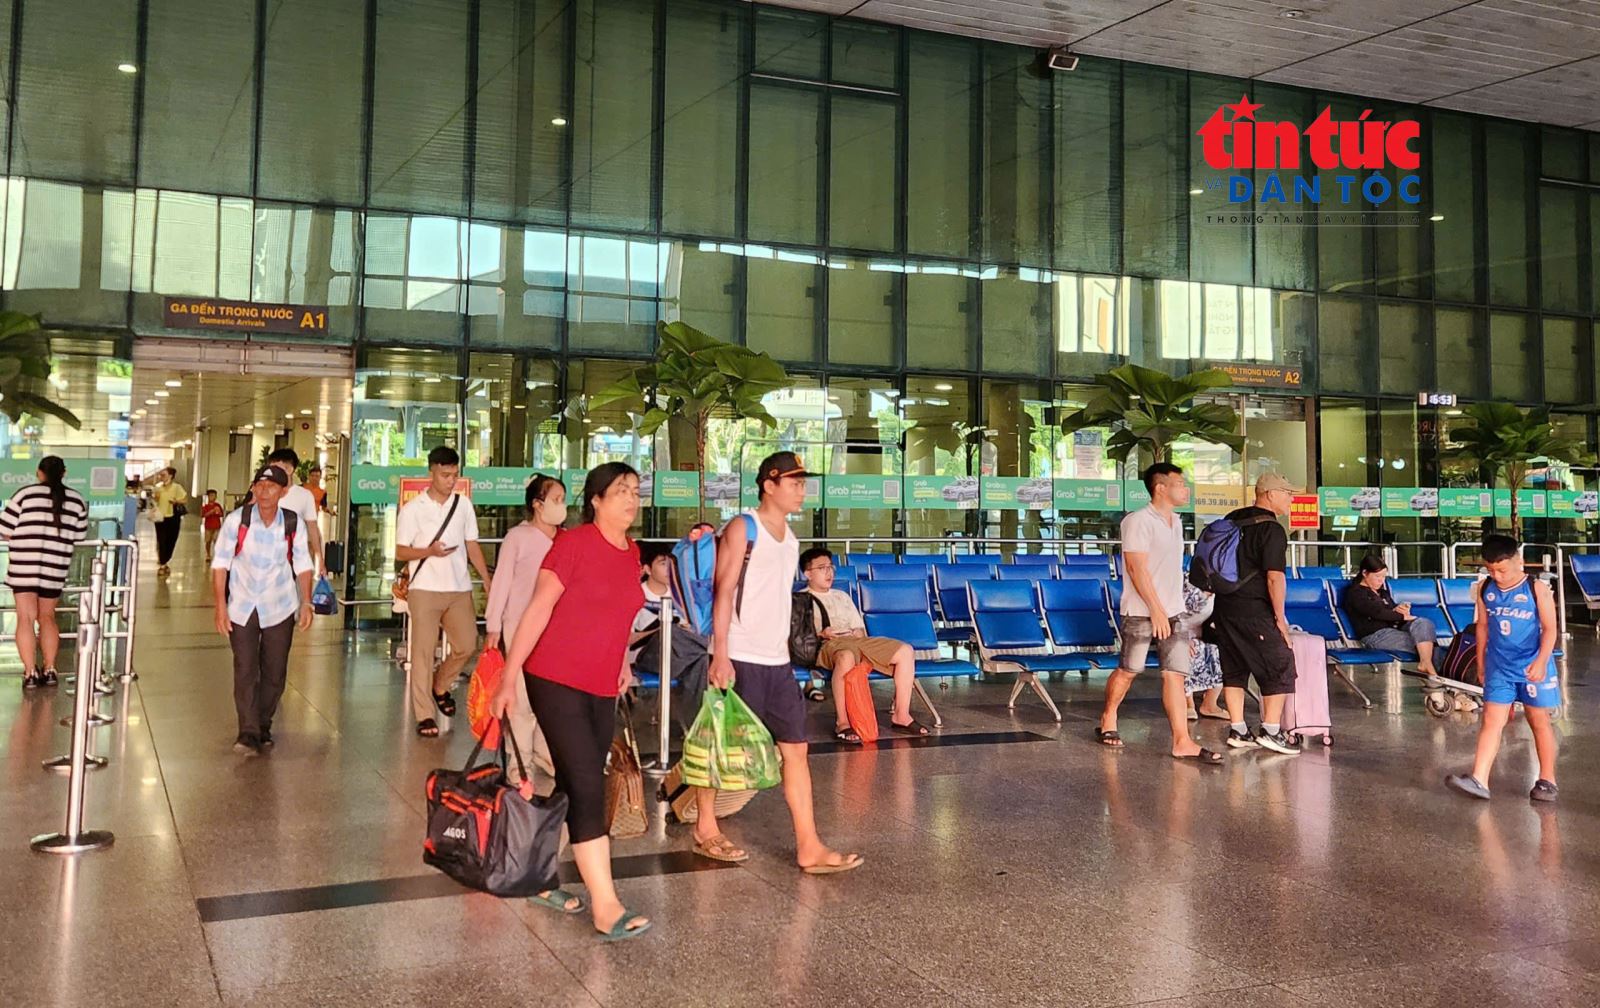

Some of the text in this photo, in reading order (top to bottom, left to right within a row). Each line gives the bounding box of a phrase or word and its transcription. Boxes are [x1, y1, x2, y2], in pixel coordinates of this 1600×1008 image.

[170, 302, 293, 320] GA ĐẾN TRONG NƯỚC
[200, 317, 265, 327] Domestic Arrivals
[300, 312, 325, 328] A1
[1238, 367, 1262, 377] TRONG
[1285, 371, 1300, 384] A2
[358, 479, 386, 489] Grab
[471, 480, 493, 490] rab
[743, 486, 759, 495] Gra
[827, 485, 849, 496] Grab
[1056, 489, 1076, 499] Grab
[1129, 490, 1148, 499] Grab
[1500, 619, 1511, 636] 9
[1526, 683, 1537, 698] 9
